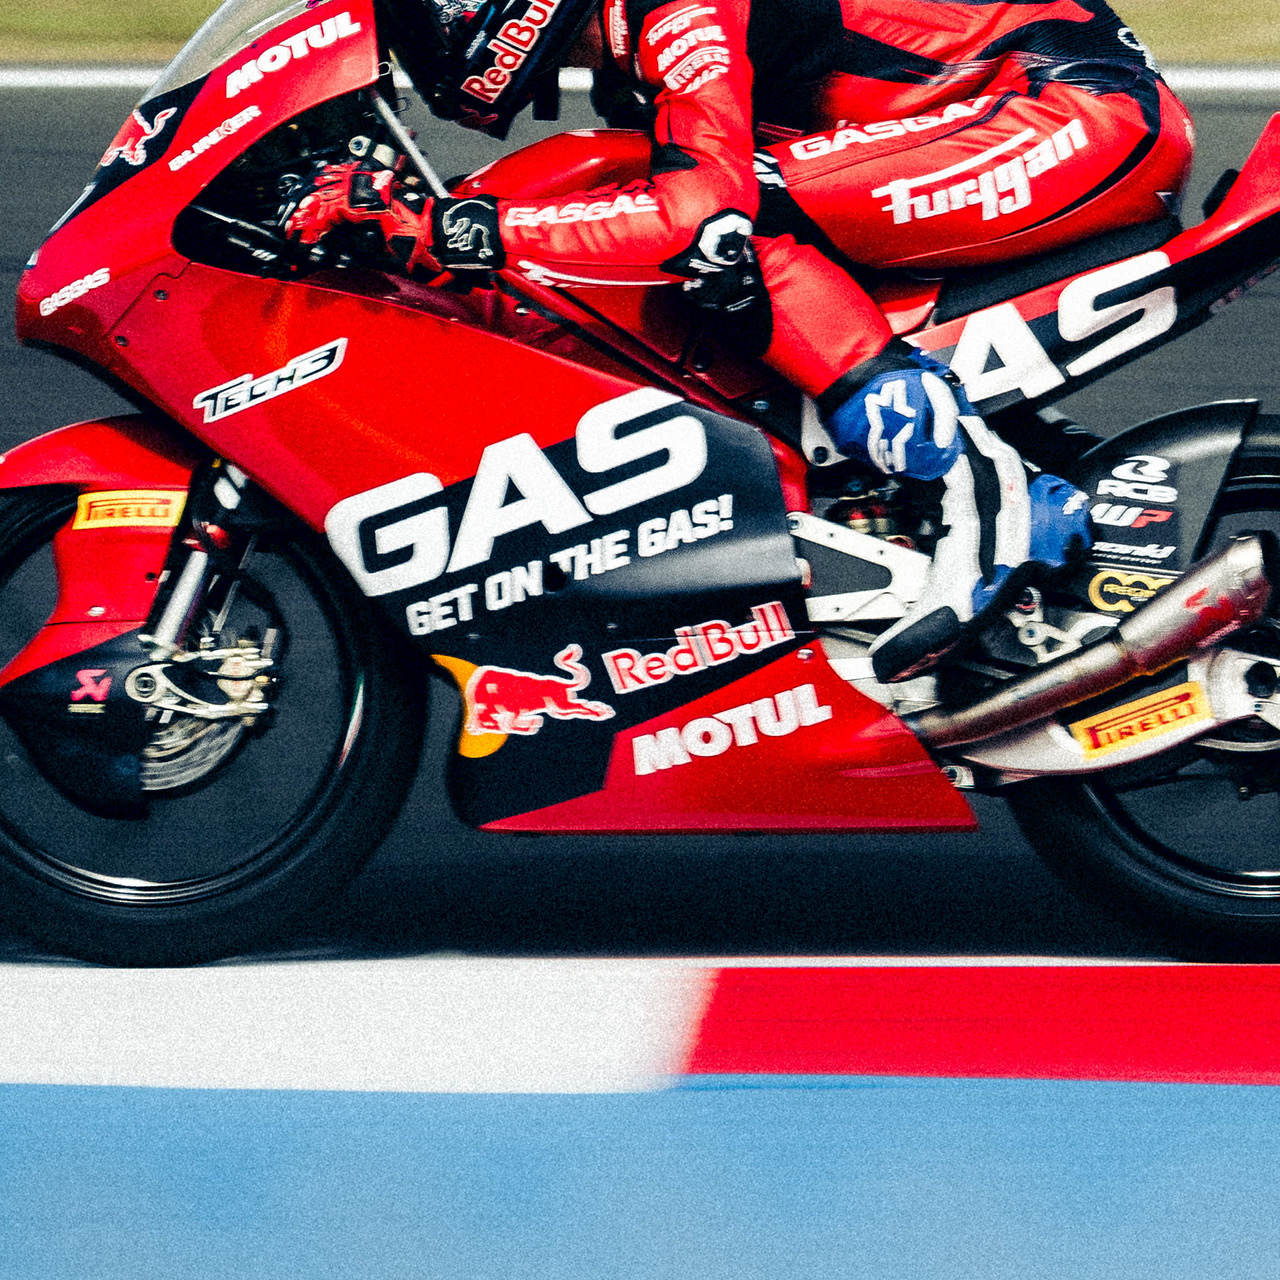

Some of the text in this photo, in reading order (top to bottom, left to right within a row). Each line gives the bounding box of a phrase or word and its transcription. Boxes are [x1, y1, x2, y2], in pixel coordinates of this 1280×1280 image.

[226, 12, 361, 99] MOTUL
[872, 119, 1088, 225] Furygan
[86, 498, 171, 521] PIRELLI
[324, 386, 708, 597] GAS
[1089, 503, 1174, 528] WP
[1096, 479, 1179, 504] RCB
[406, 494, 734, 636] GET ON THE GAS!
[632, 683, 833, 776] MOTUL
[1084, 692, 1196, 750] PIRELLI
